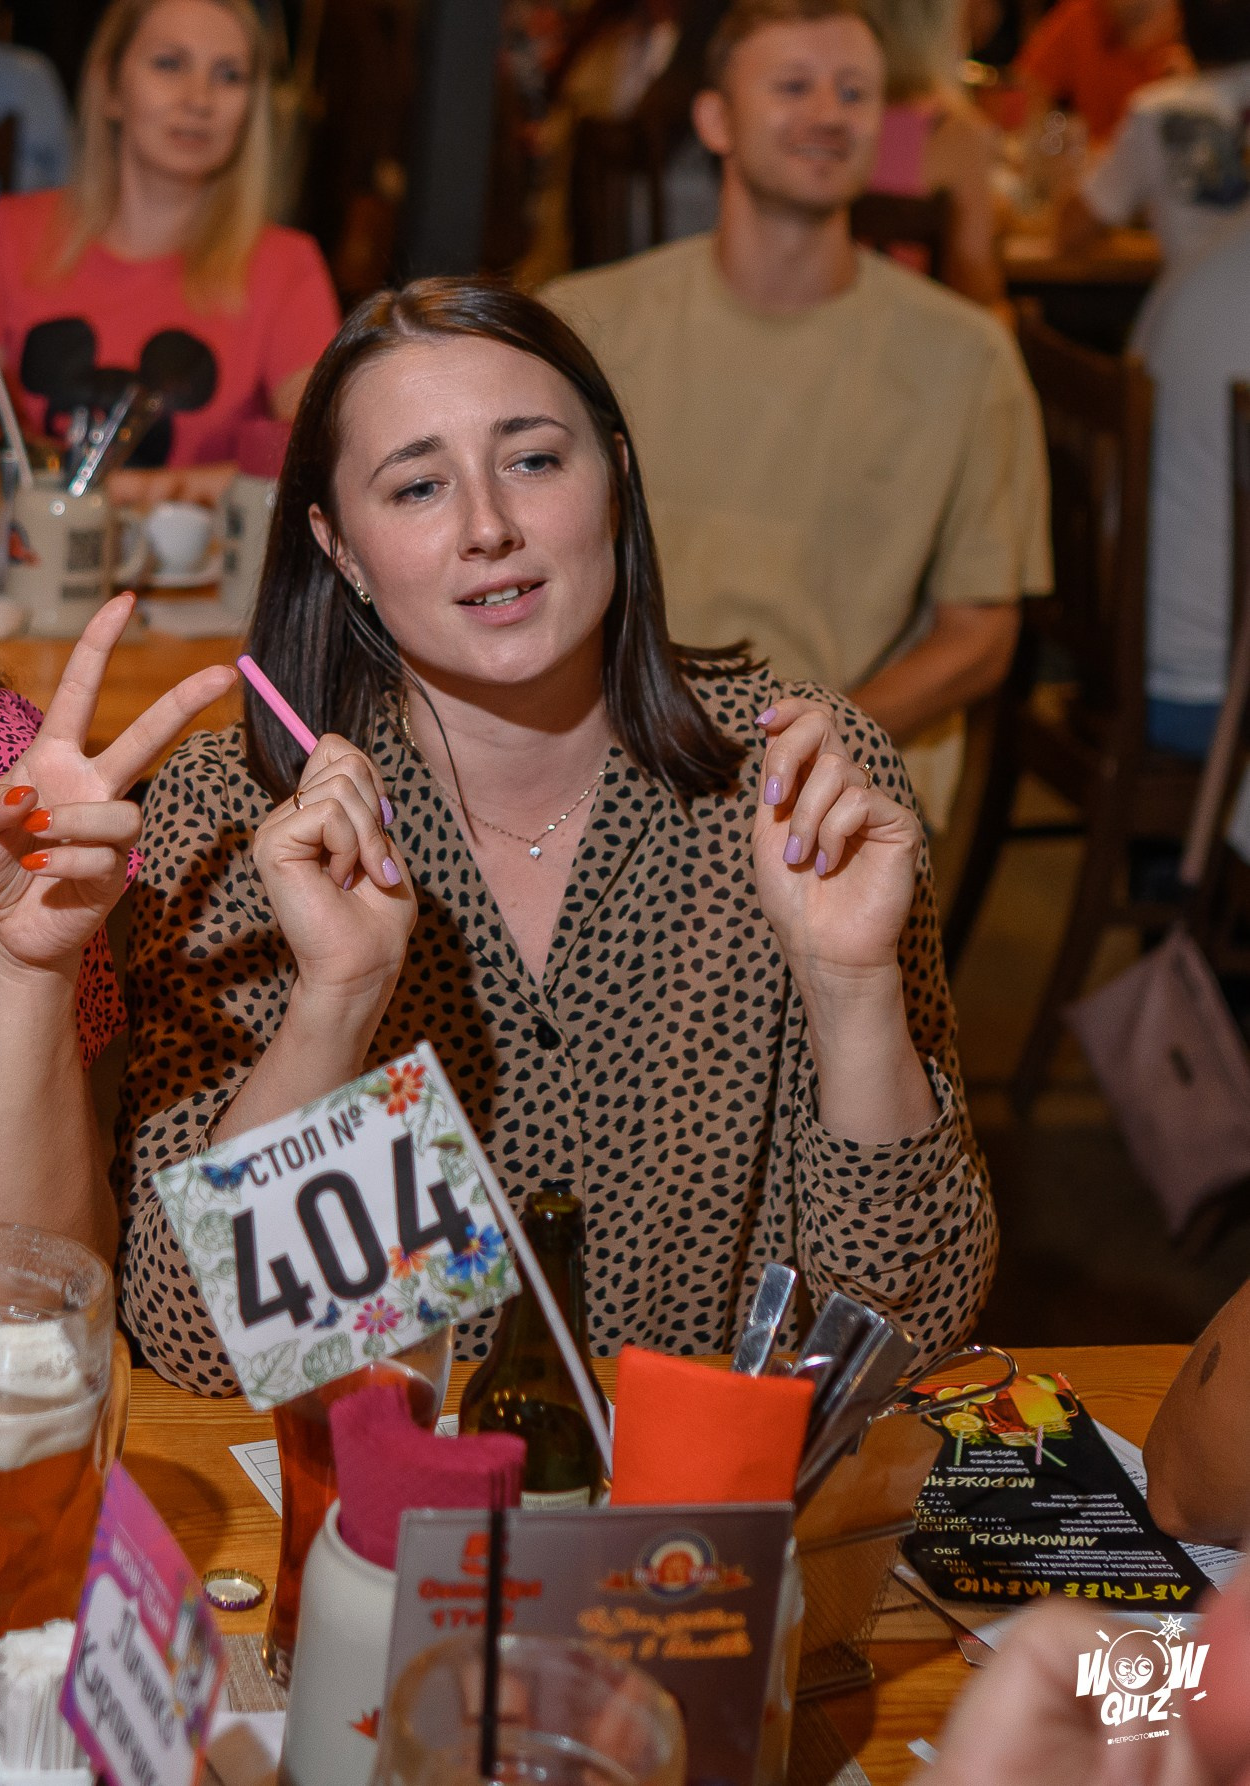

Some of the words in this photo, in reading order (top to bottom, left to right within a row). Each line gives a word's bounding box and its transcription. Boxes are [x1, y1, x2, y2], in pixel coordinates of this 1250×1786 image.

[244, 1133, 327, 1186] СТОЛ
[330, 1104, 365, 1149] №
[232, 1131, 474, 1331] 404
[969, 1532, 1098, 1547] ЛИМОНАДЫ
[934, 1547, 961, 1555] 290
[1070, 1554, 1167, 1562] Бананово-клубничный
[1111, 1562, 1146, 1570] Капрезе
[953, 1577, 1050, 1598] МЕНЮ
[1063, 1581, 1190, 1600] ЛЕТНЕЕ
